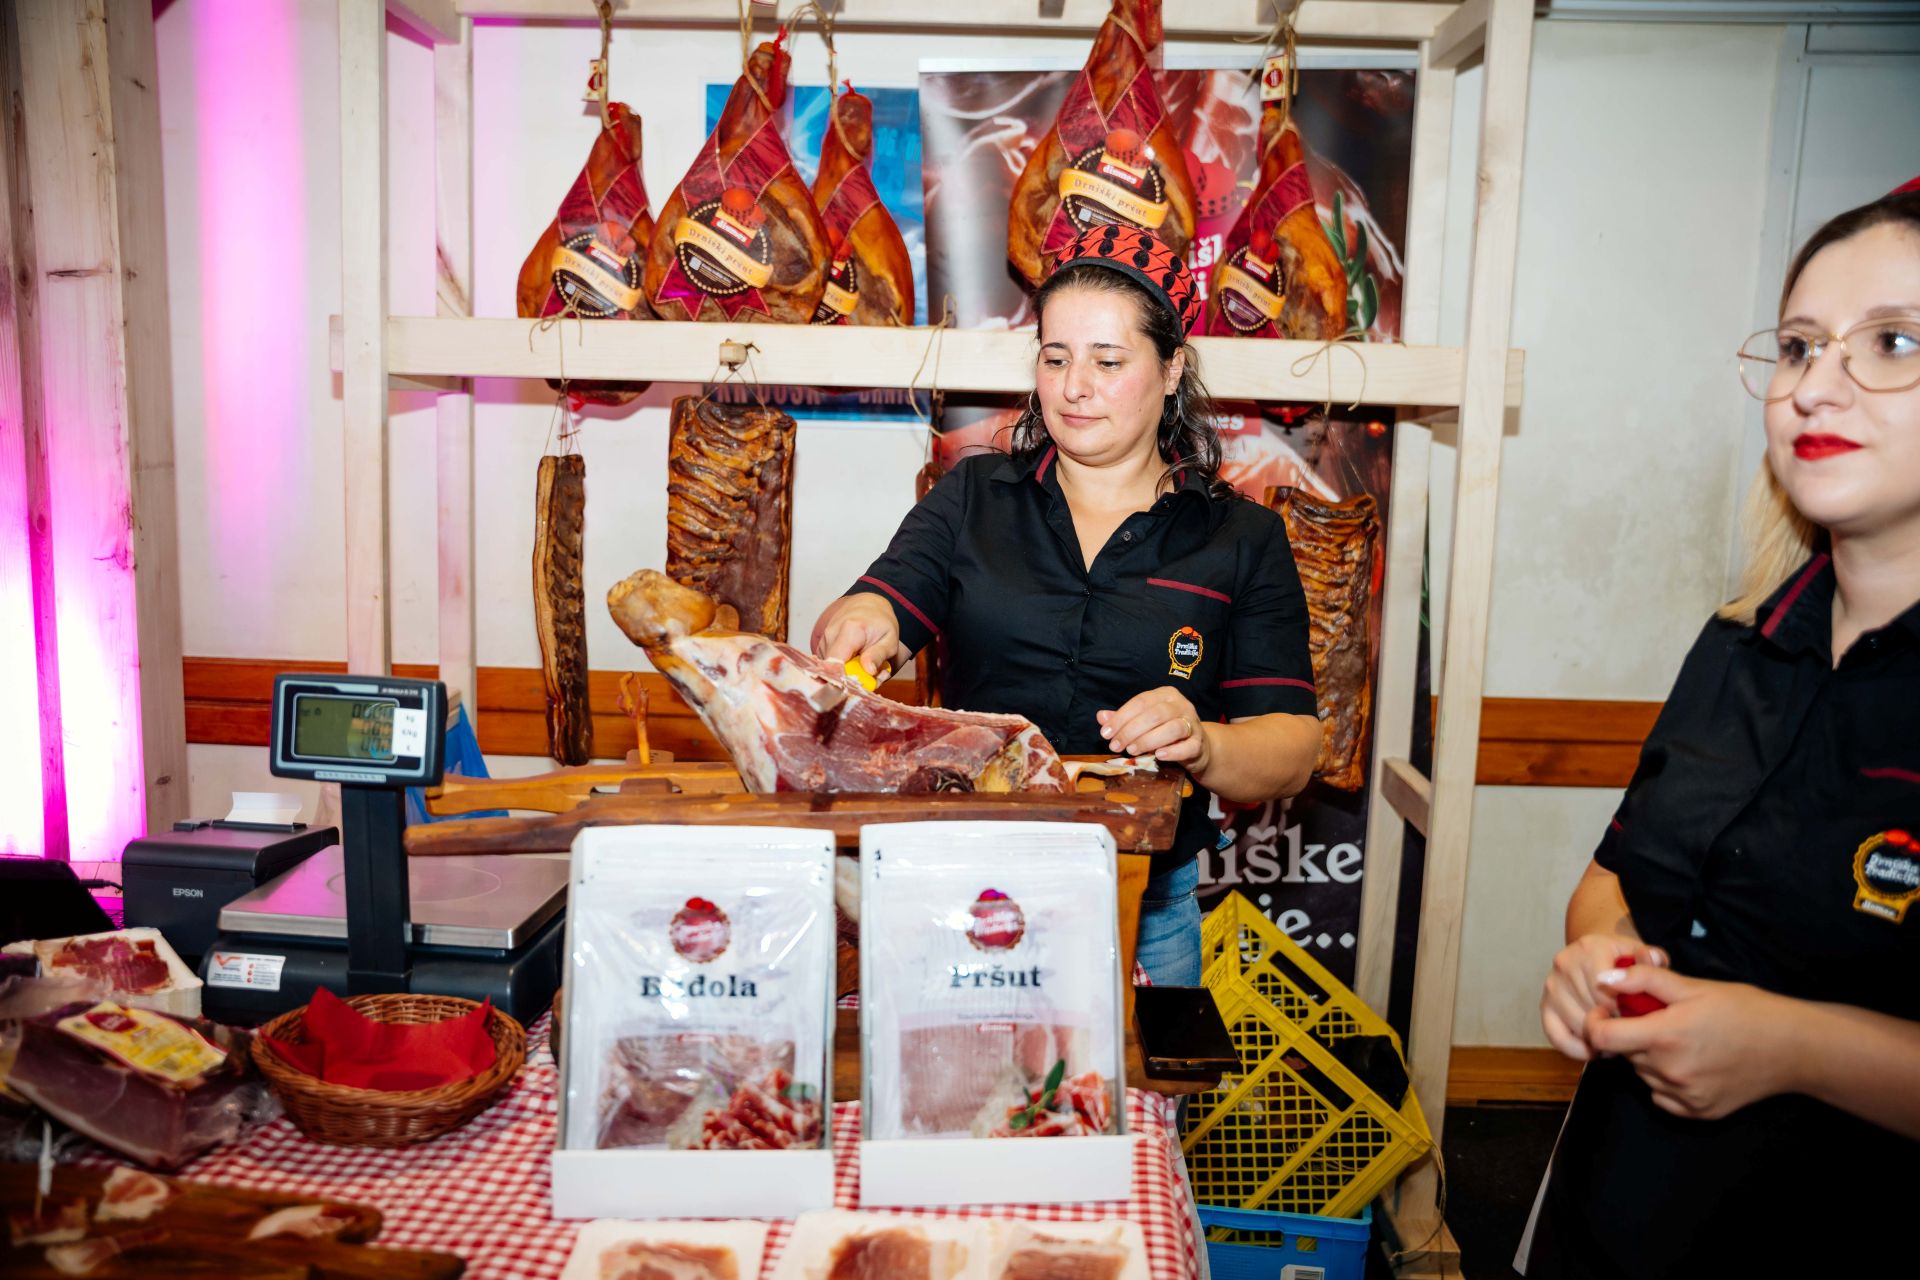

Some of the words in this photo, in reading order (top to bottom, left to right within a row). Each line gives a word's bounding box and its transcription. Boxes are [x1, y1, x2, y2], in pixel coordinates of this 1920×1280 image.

[173, 887, 204, 899] EPSON
[640, 974, 758, 998] Bdola
[950, 964, 1041, 989] Pršut
